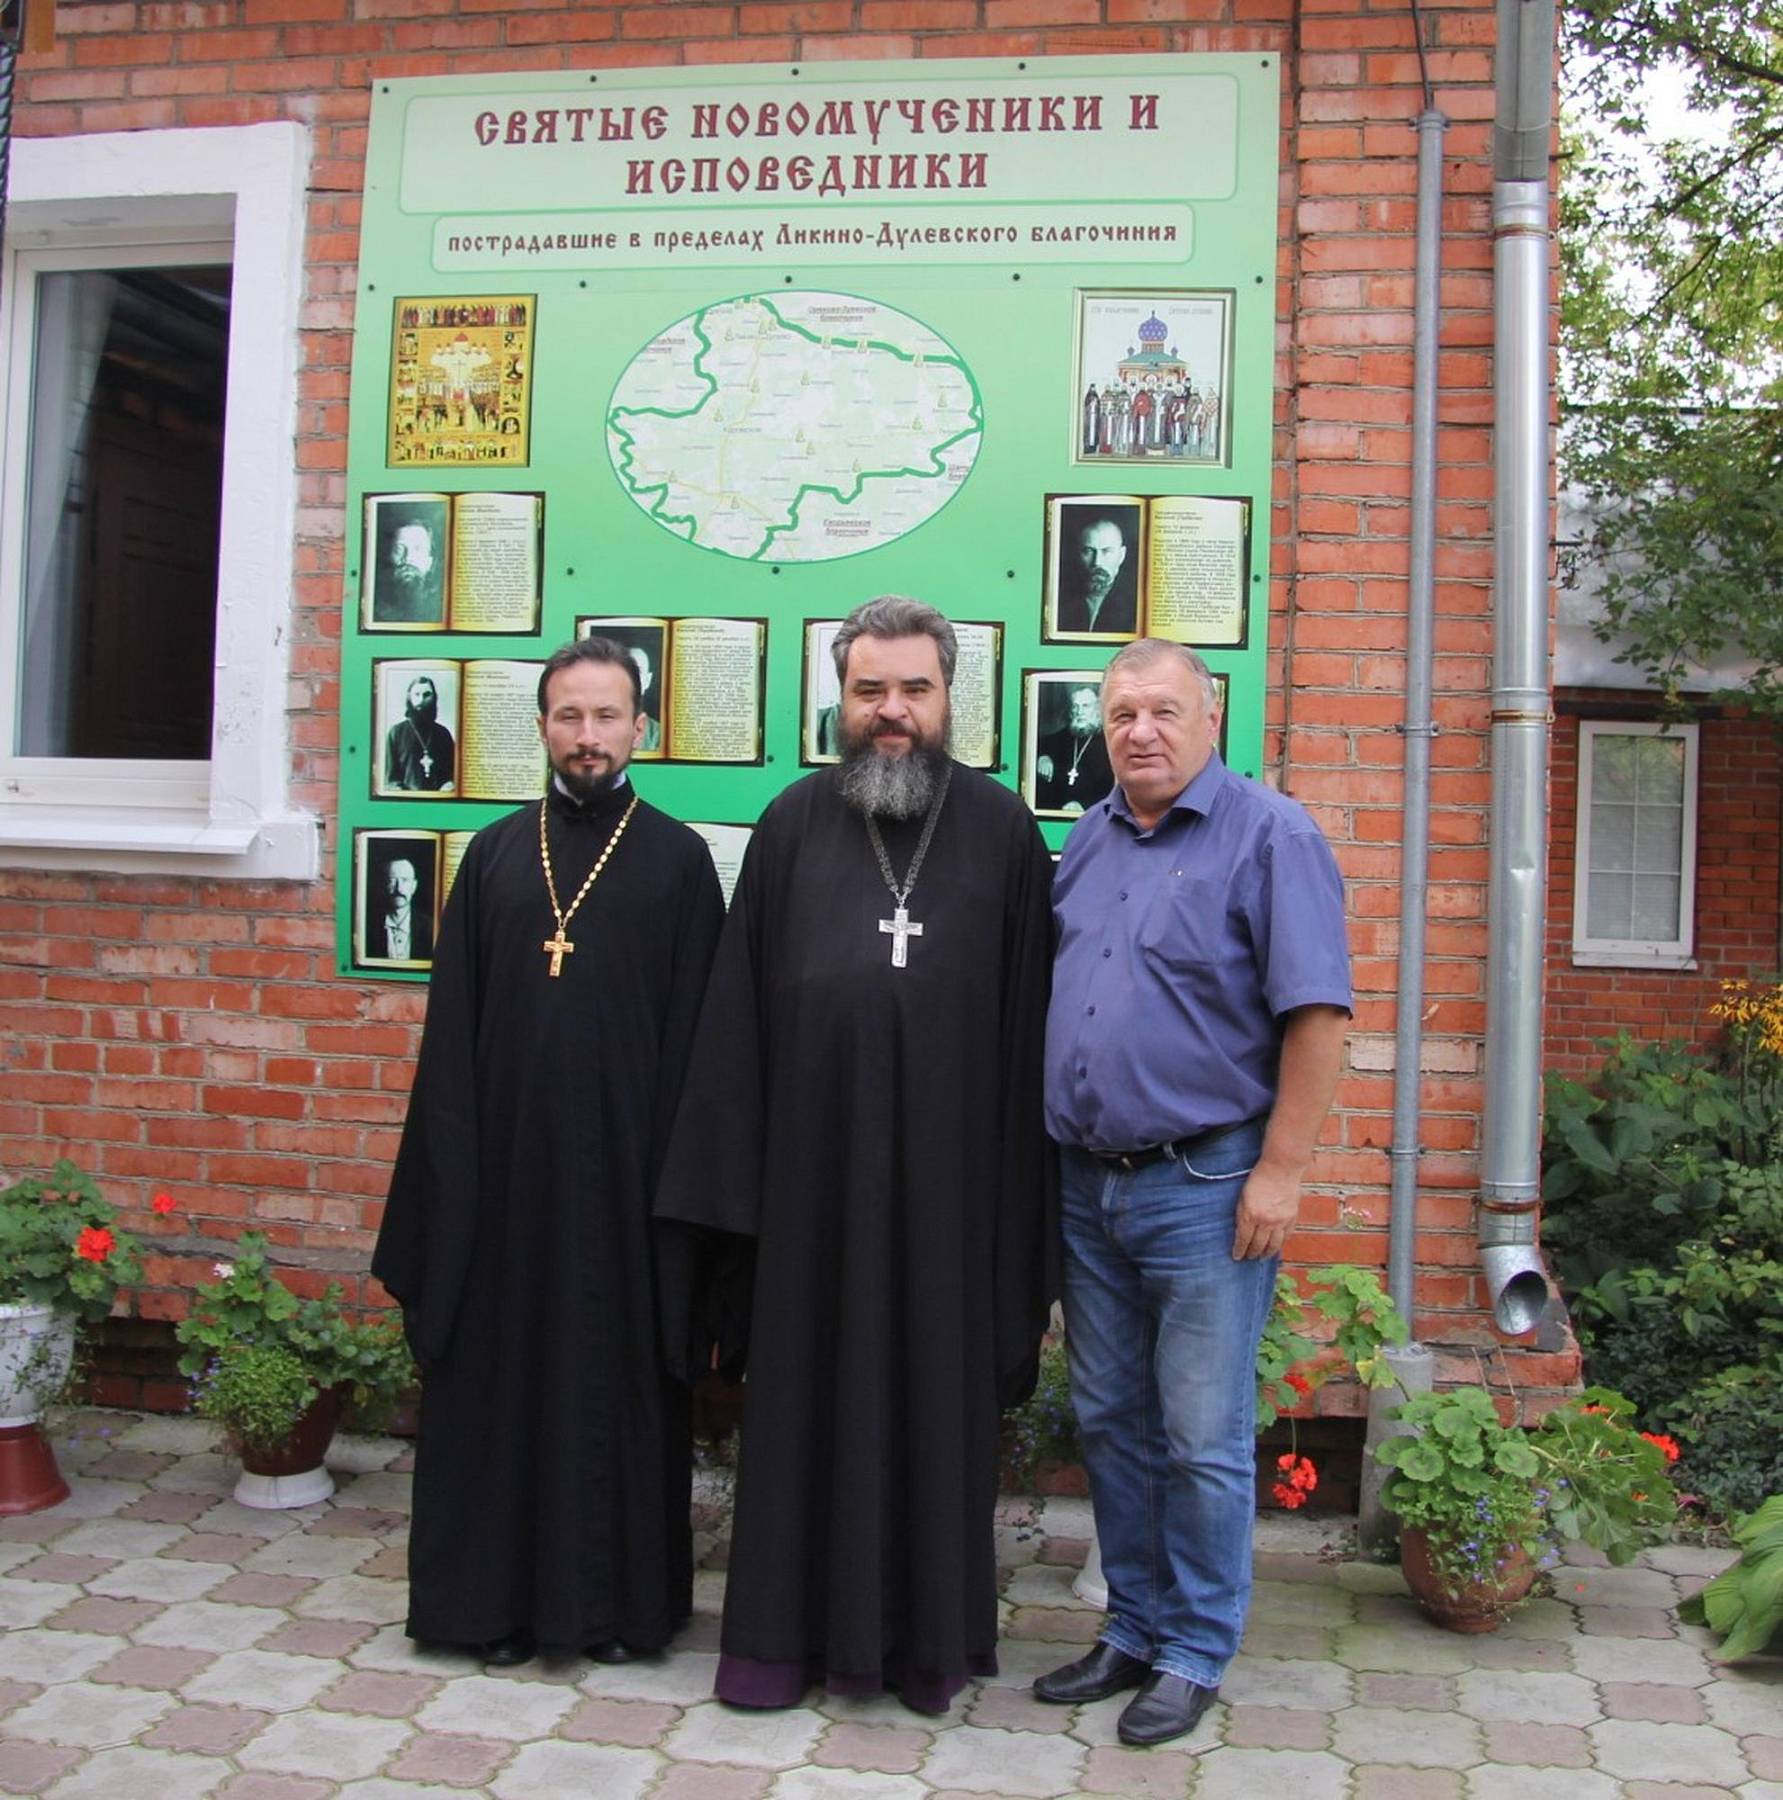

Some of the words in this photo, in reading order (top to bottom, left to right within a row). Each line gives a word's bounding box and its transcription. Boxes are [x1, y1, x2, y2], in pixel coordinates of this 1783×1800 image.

[474, 105, 669, 146] СВЯТЫЕ
[690, 95, 1104, 145] НОВОМУЧЕНИКИ
[1128, 94, 1160, 130] И
[625, 152, 989, 197] ИСПОВЕДНИКИ
[654, 230, 764, 253] пределах
[776, 221, 1018, 251] Ликино-Дулевского
[1031, 225, 1177, 243] благочиния
